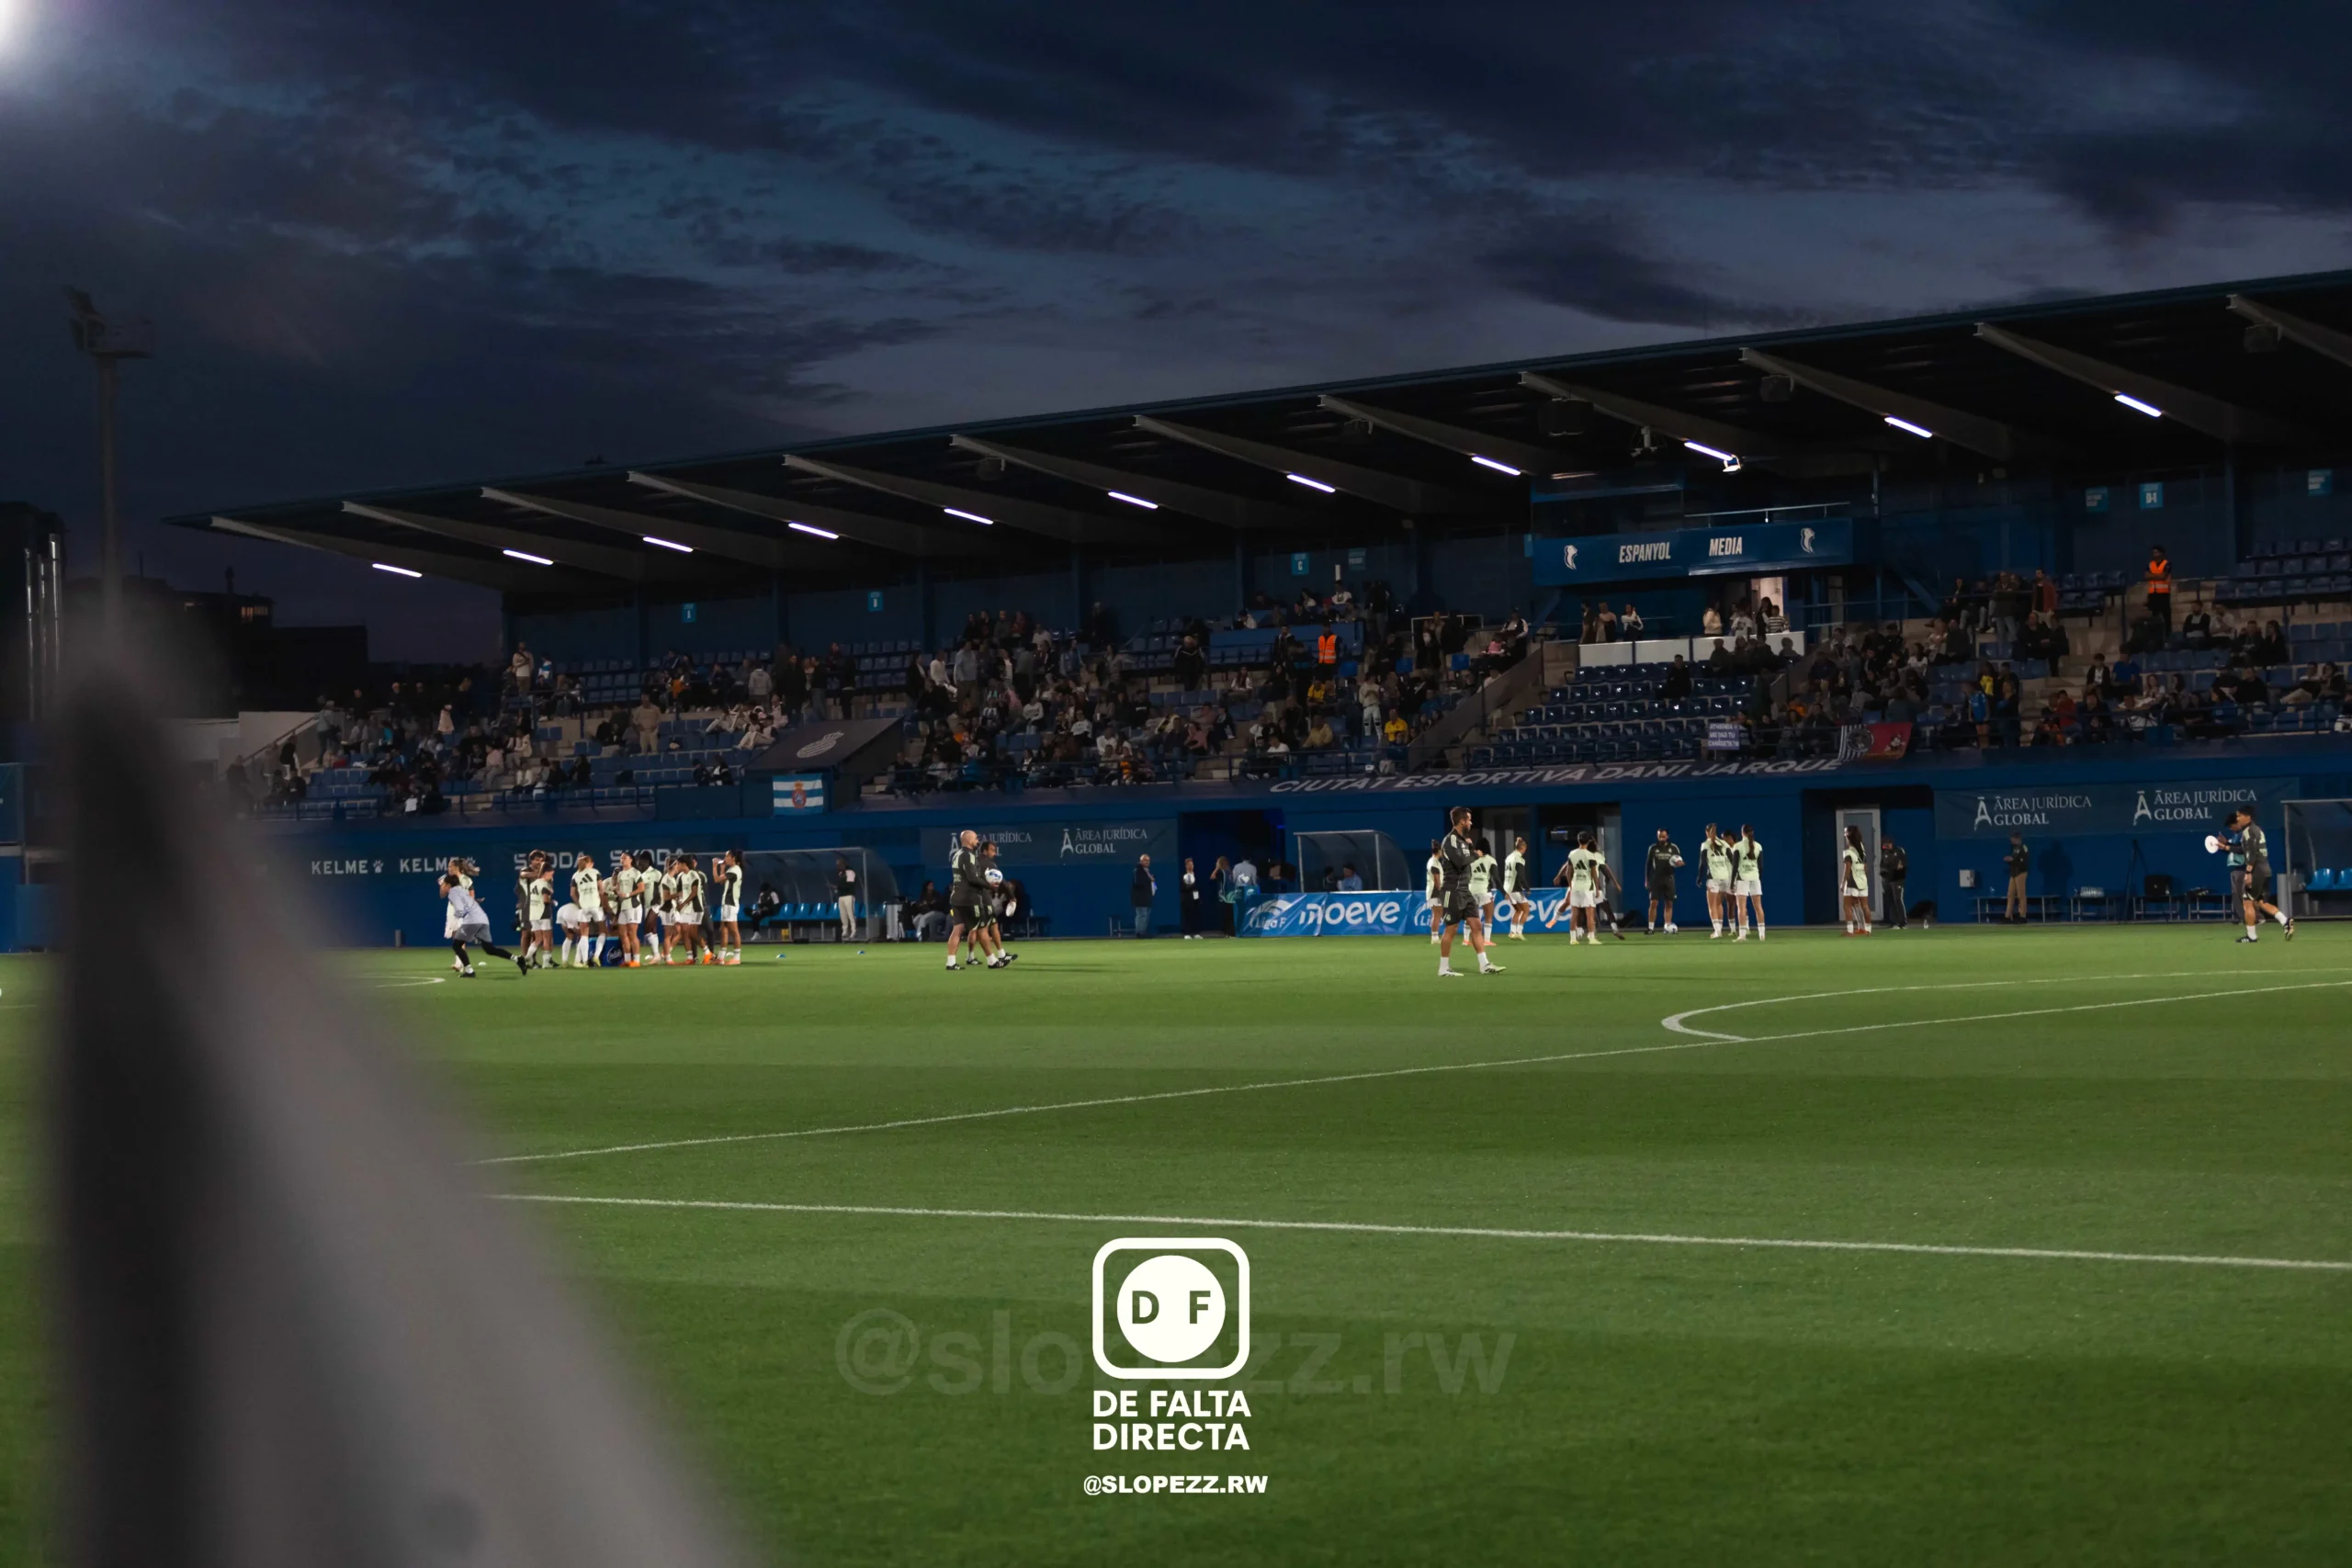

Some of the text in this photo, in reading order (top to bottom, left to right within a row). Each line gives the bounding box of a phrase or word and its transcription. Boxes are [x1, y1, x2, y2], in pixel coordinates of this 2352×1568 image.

[1619, 536, 1743, 563] ESPANYOL MEDIA
[1270, 759, 1842, 793] CIUTAT ESPORTIVA DANI JARQUE
[2030, 794, 2092, 812] JURÍDICA
[2193, 787, 2257, 807] JURÍDICA
[1994, 812, 2049, 826] GLOBAL
[2154, 807, 2212, 821] GLOBAL
[989, 830, 1033, 843] JURÍDICA
[1102, 827, 1148, 842] JURÍDICA
[1075, 843, 1116, 854] GLOBAL
[311, 856, 459, 874] KELME KELM
[514, 851, 585, 870] SODA
[1298, 901, 1401, 926] moeve
[1278, 917, 1286, 929] F
